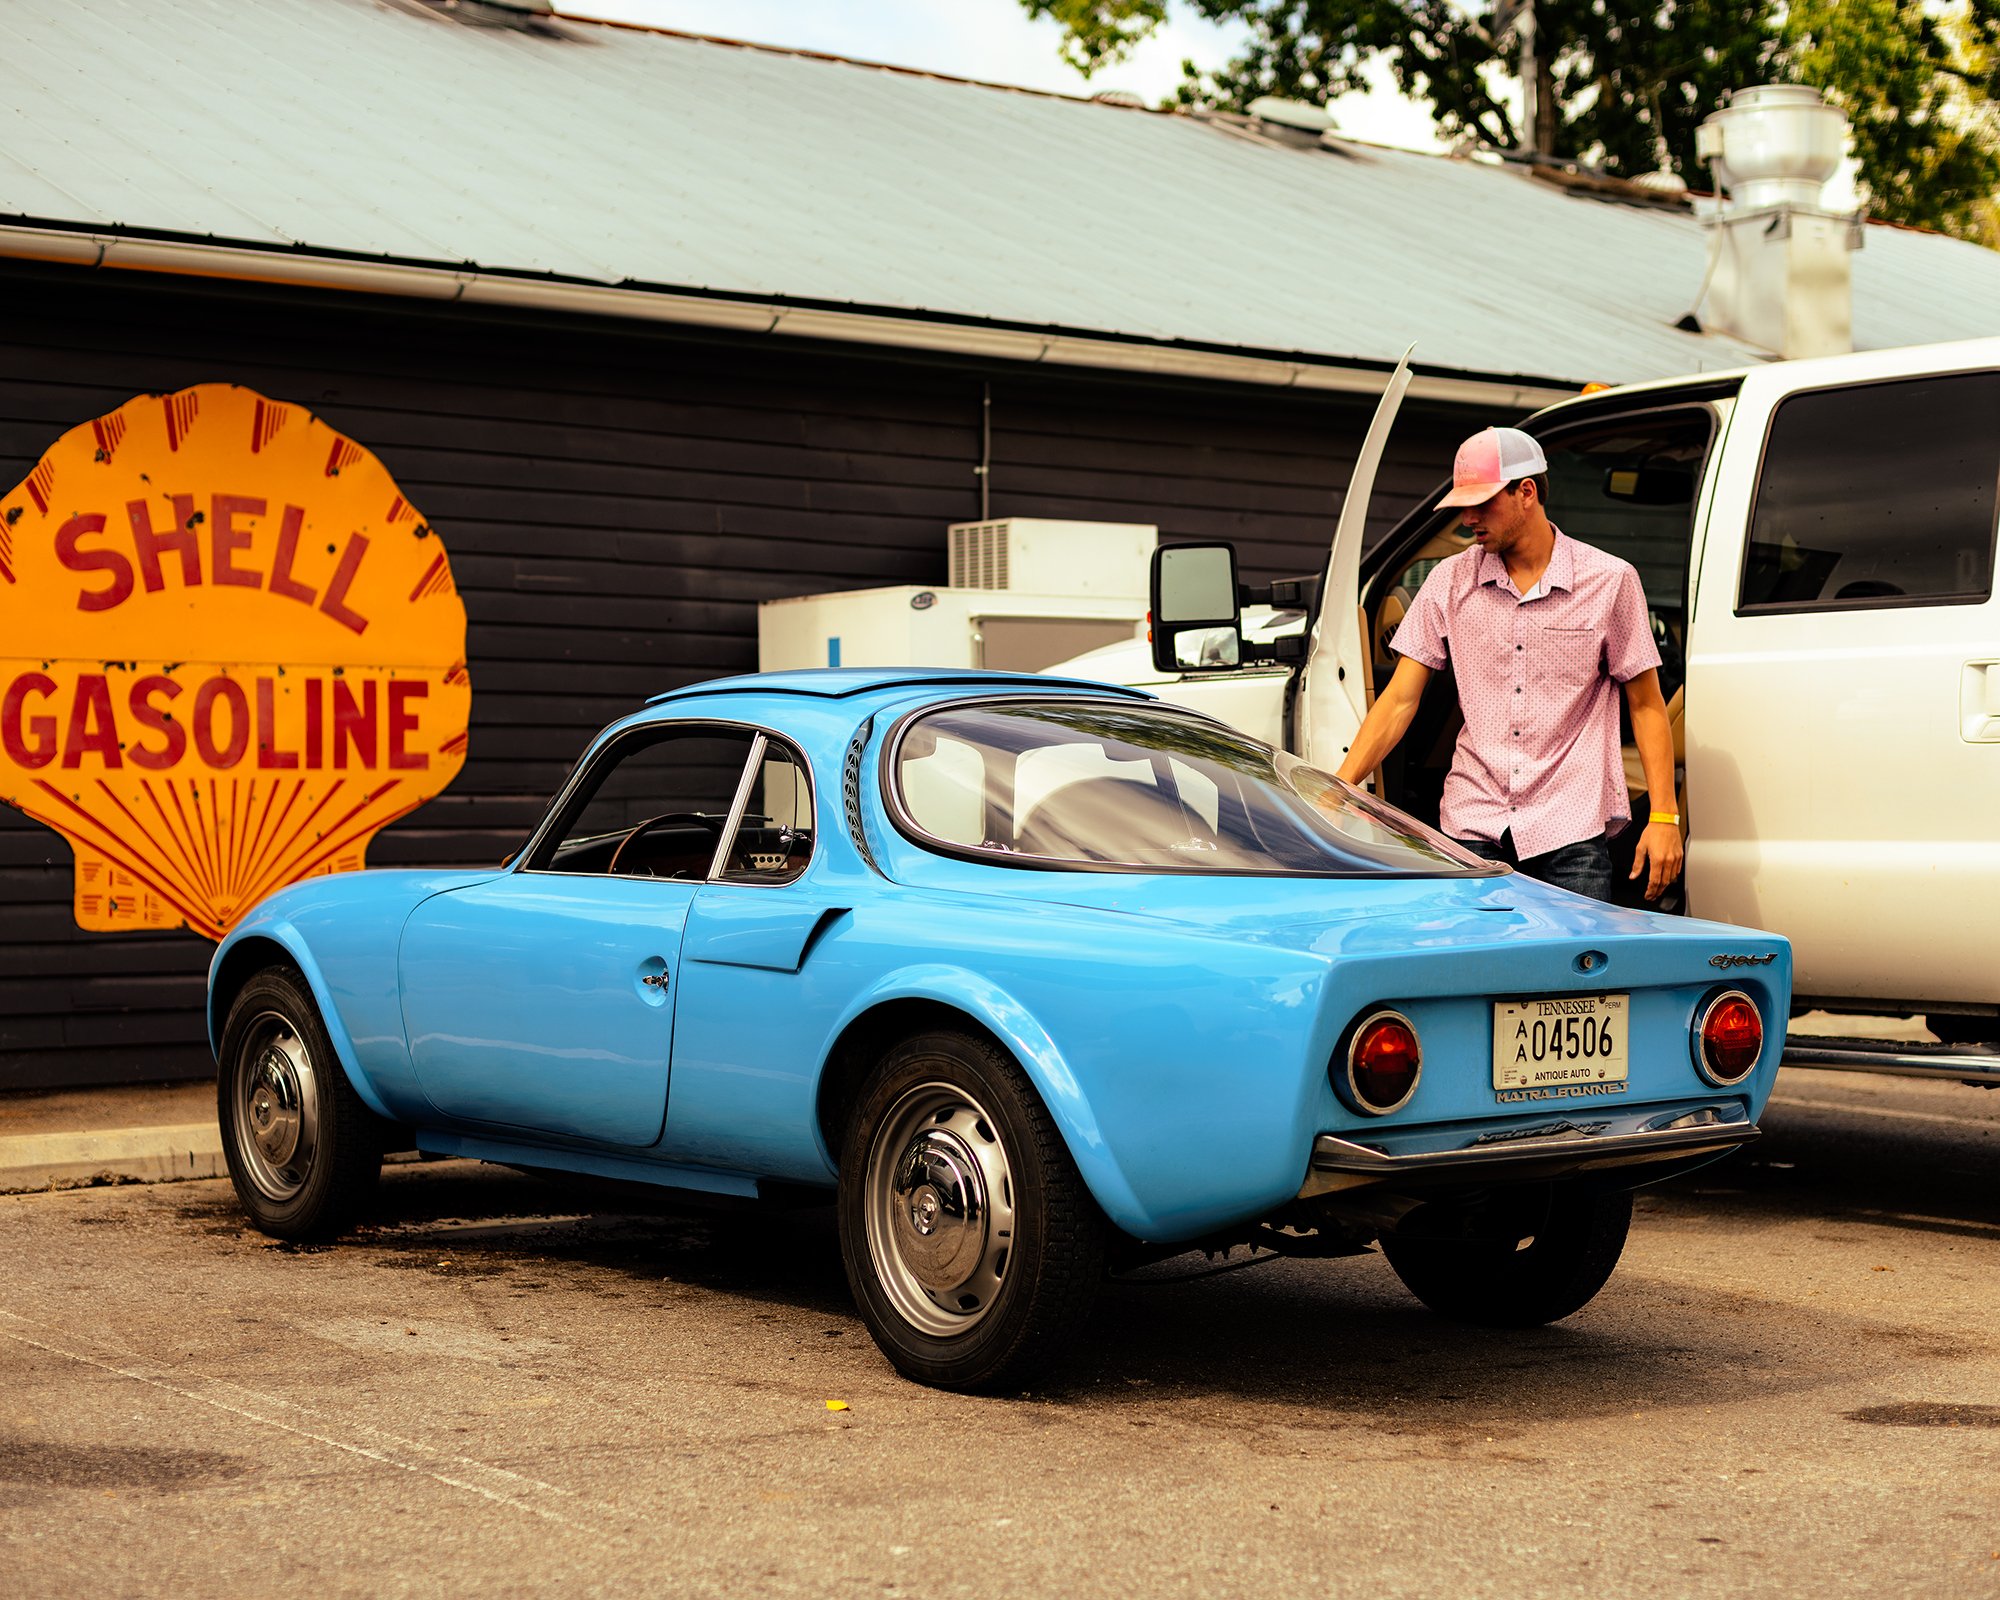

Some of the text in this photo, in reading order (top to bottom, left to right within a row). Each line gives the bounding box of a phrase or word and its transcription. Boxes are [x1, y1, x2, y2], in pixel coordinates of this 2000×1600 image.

[54, 493, 370, 636] SHELL
[1, 671, 430, 771] GASOLINE
[1536, 999, 1595, 1016] TENNESSEE
[1604, 1001, 1621, 1010] PERM
[1531, 1015, 1613, 1061] 04506
[1534, 1068, 1591, 1081] ANTIQUE AUTO
[1496, 1082, 1629, 1104] MATRA BONNET
